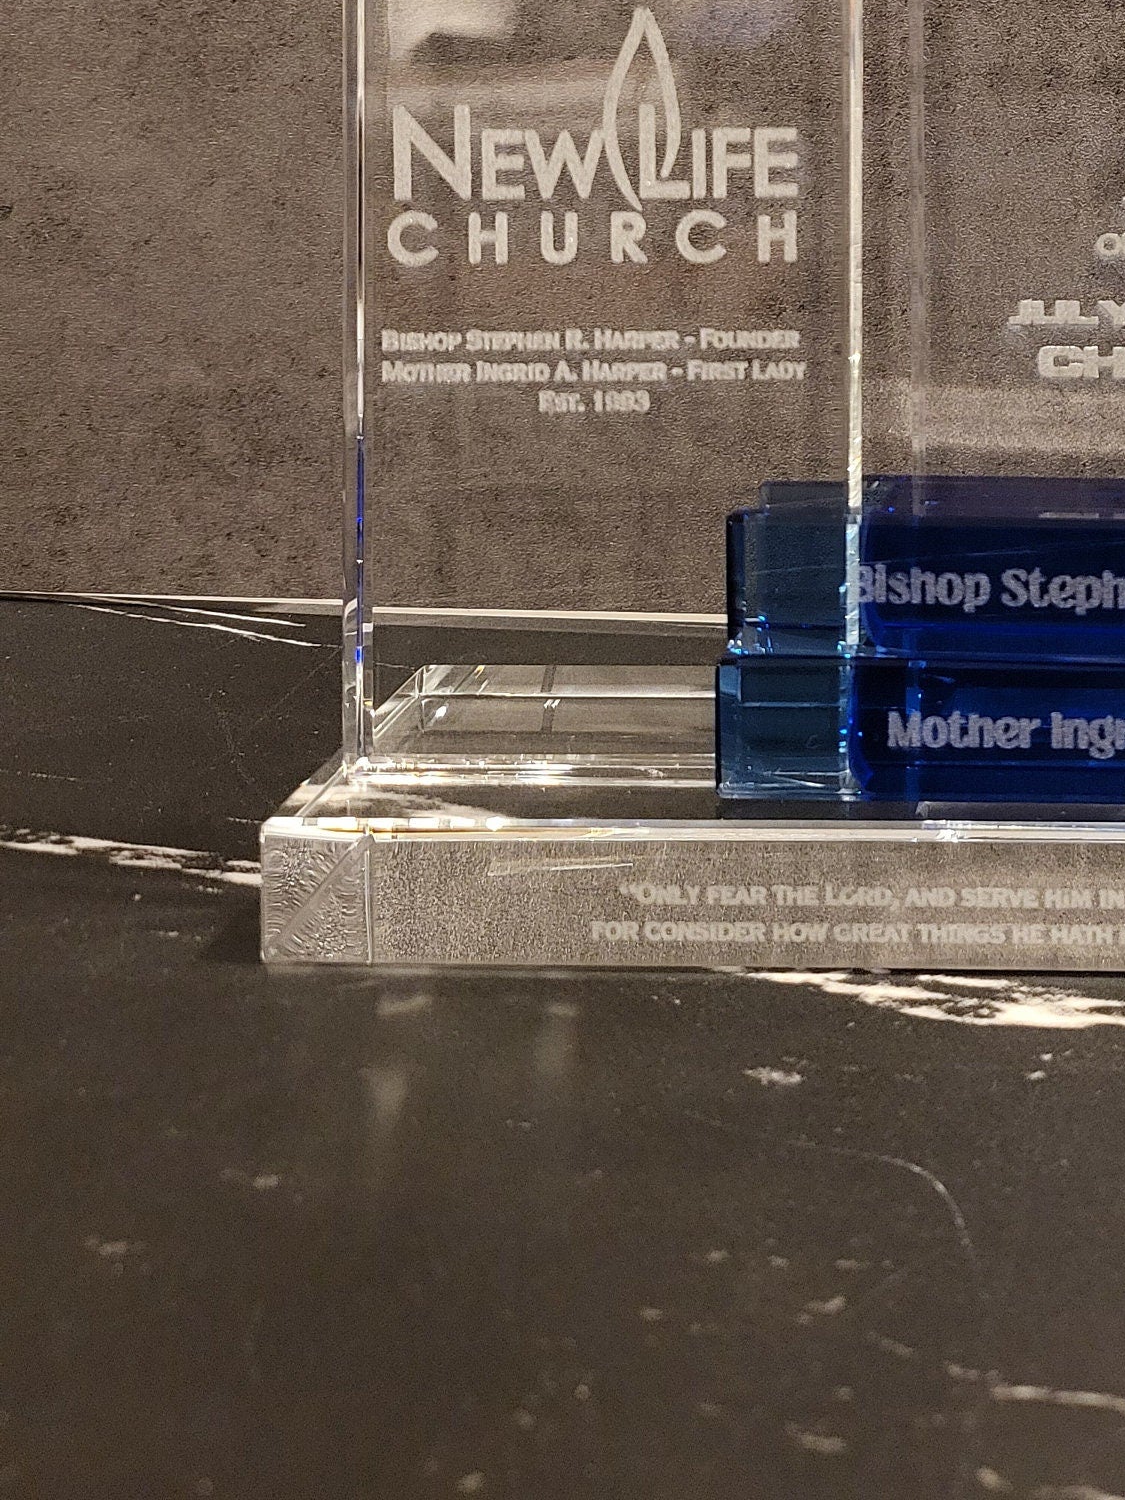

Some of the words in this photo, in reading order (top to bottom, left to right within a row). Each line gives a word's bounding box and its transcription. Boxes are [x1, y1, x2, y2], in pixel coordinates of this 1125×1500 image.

[391, 103, 603, 201] NEW
[387, 209, 799, 267] CHURCH
[700, 327, 800, 350] FOUNDER
[475, 360, 551, 383] INGRID
[857, 562, 991, 614] Bishop
[887, 710, 1042, 749] Mother
[706, 885, 768, 906] FEAR
[771, 885, 821, 906] THE
[904, 886, 955, 907] AND
[591, 921, 639, 942] FOR
[643, 921, 766, 943] CONSIDER
[772, 922, 829, 943] HOW
[833, 922, 912, 944] GREAT
